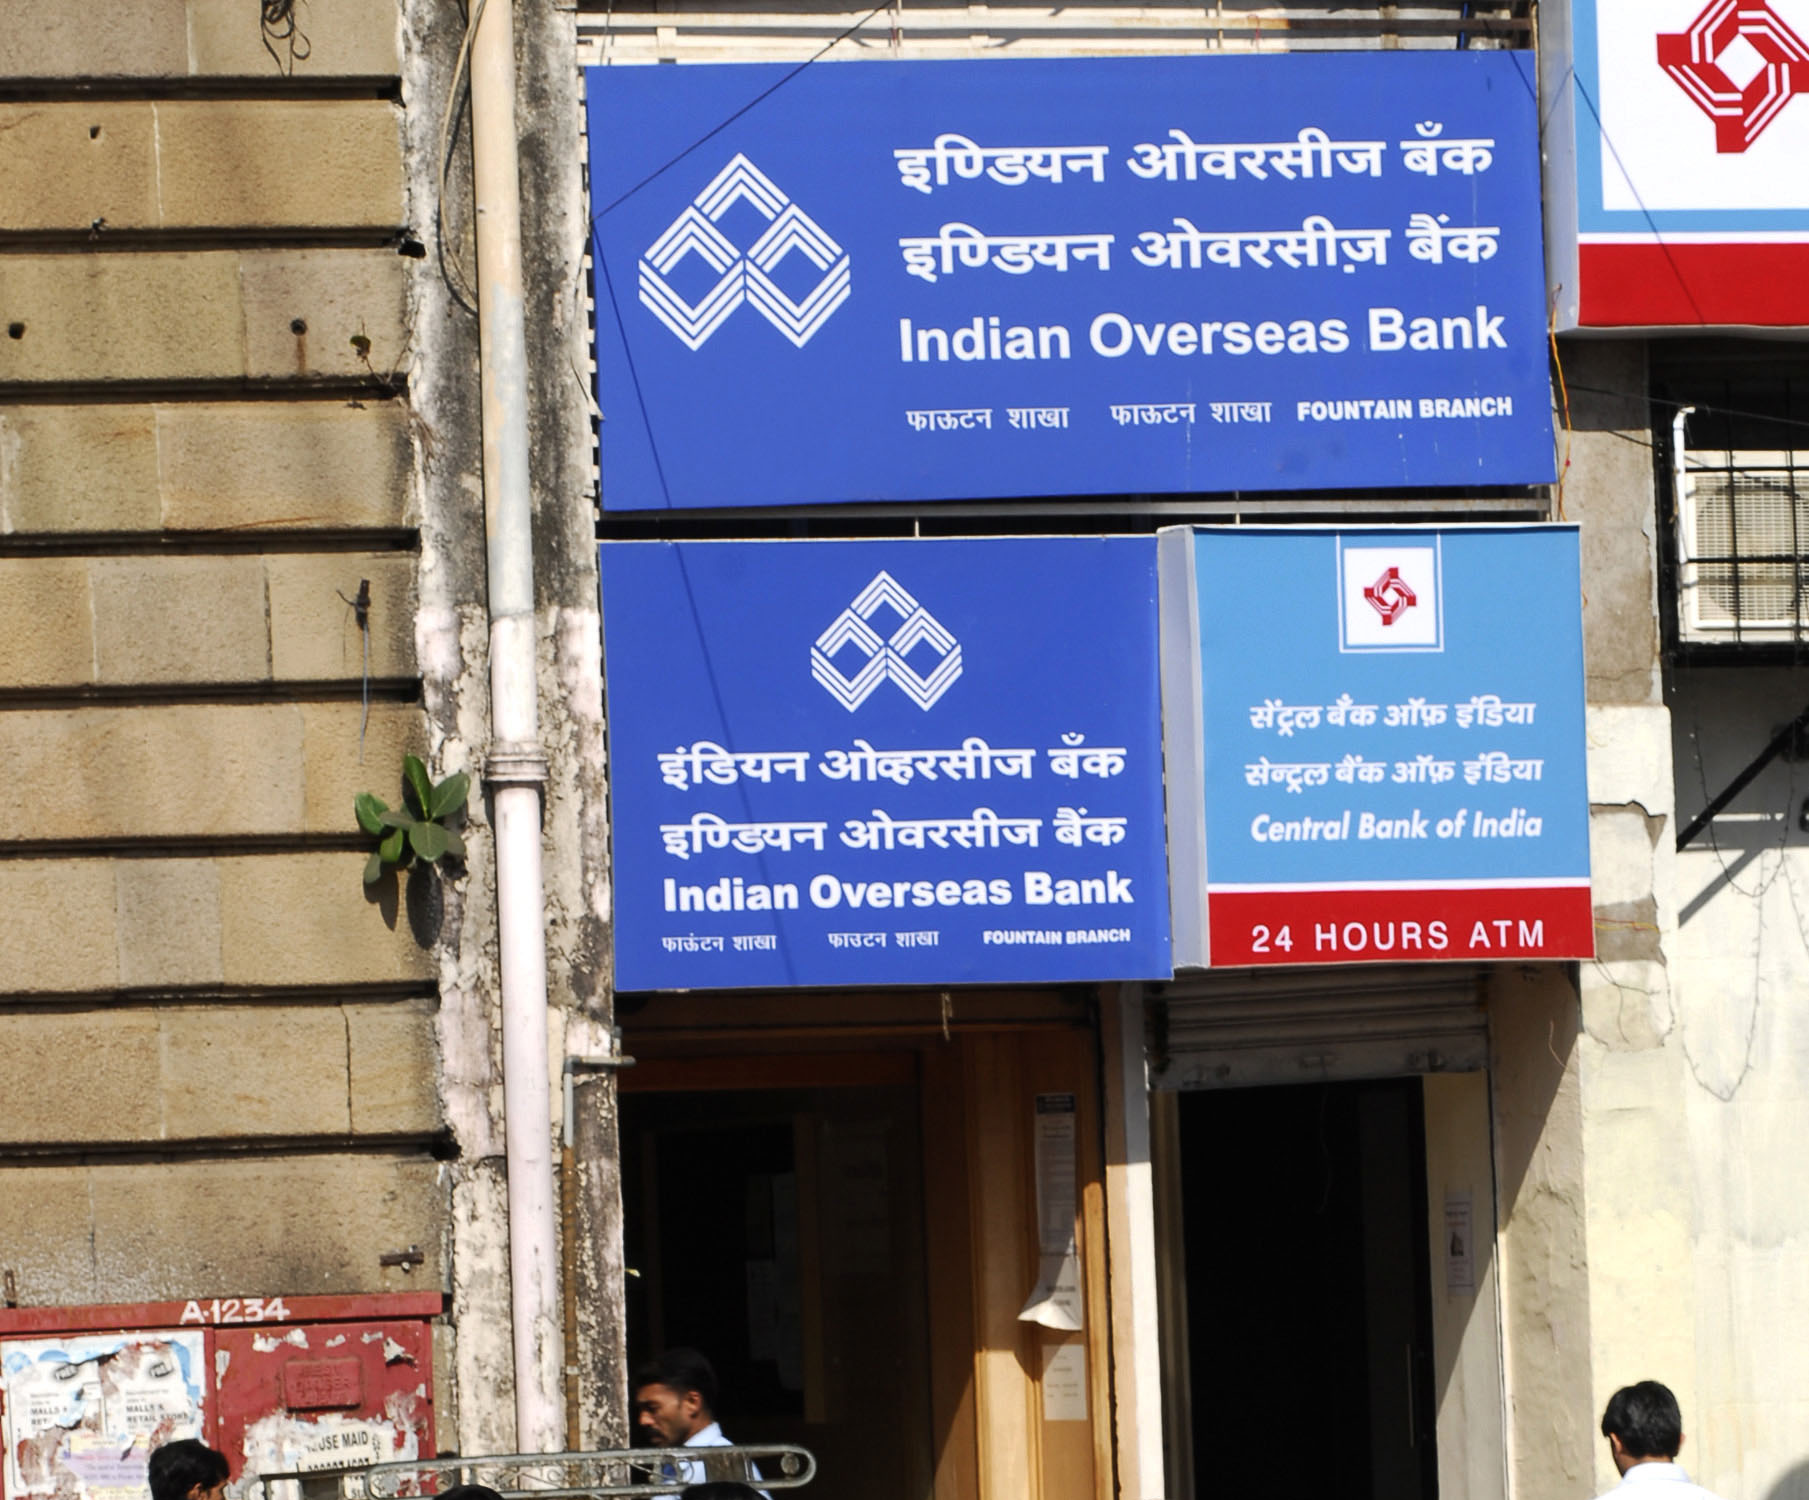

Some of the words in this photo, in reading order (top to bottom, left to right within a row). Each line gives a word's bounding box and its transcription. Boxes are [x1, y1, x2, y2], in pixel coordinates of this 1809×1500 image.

[894, 134, 1109, 193] इण्डियन
[1127, 128, 1386, 180] ओवरसीज
[899, 223, 1114, 282] इण्डियन
[1406, 214, 1500, 263] बैंक
[901, 317, 1070, 361] Indian
[1090, 313, 1349, 357] Overseas
[1369, 306, 1507, 350] Bank
[1007, 408, 1069, 428] शाखा
[1210, 403, 1272, 422] शाखा
[1298, 401, 1412, 421] FOUNTAIN
[1419, 397, 1512, 418] BRANCH
[1250, 699, 1323, 736] सेंट्रल
[1455, 695, 1536, 728] इंडिया
[658, 740, 809, 790] इंडियन
[1245, 757, 1331, 793] सेन्ट्रल
[1335, 754, 1387, 783] बैंक
[1463, 752, 1544, 785] इंडिया
[660, 813, 827, 859] इण्डियन
[840, 808, 1042, 850] ओवरसीज
[1053, 807, 1127, 847] बैंक
[1251, 810, 1350, 842] Central
[1358, 809, 1429, 839] Bank
[1436, 808, 1467, 838] of
[1473, 808, 1542, 837] India
[664, 878, 798, 911] Indian
[810, 875, 1012, 908] Overseas
[1025, 871, 1133, 905] Bank
[733, 935, 776, 950] शाखा
[896, 931, 939, 947] शाखा
[983, 930, 1061, 944] FOUNTAIN
[1066, 928, 1131, 944] BRANCH
[1252, 924, 1293, 952] 24
[1315, 921, 1448, 950] HOURS
[1469, 920, 1544, 948] ATM
[342, 1431, 369, 1448] MAID
